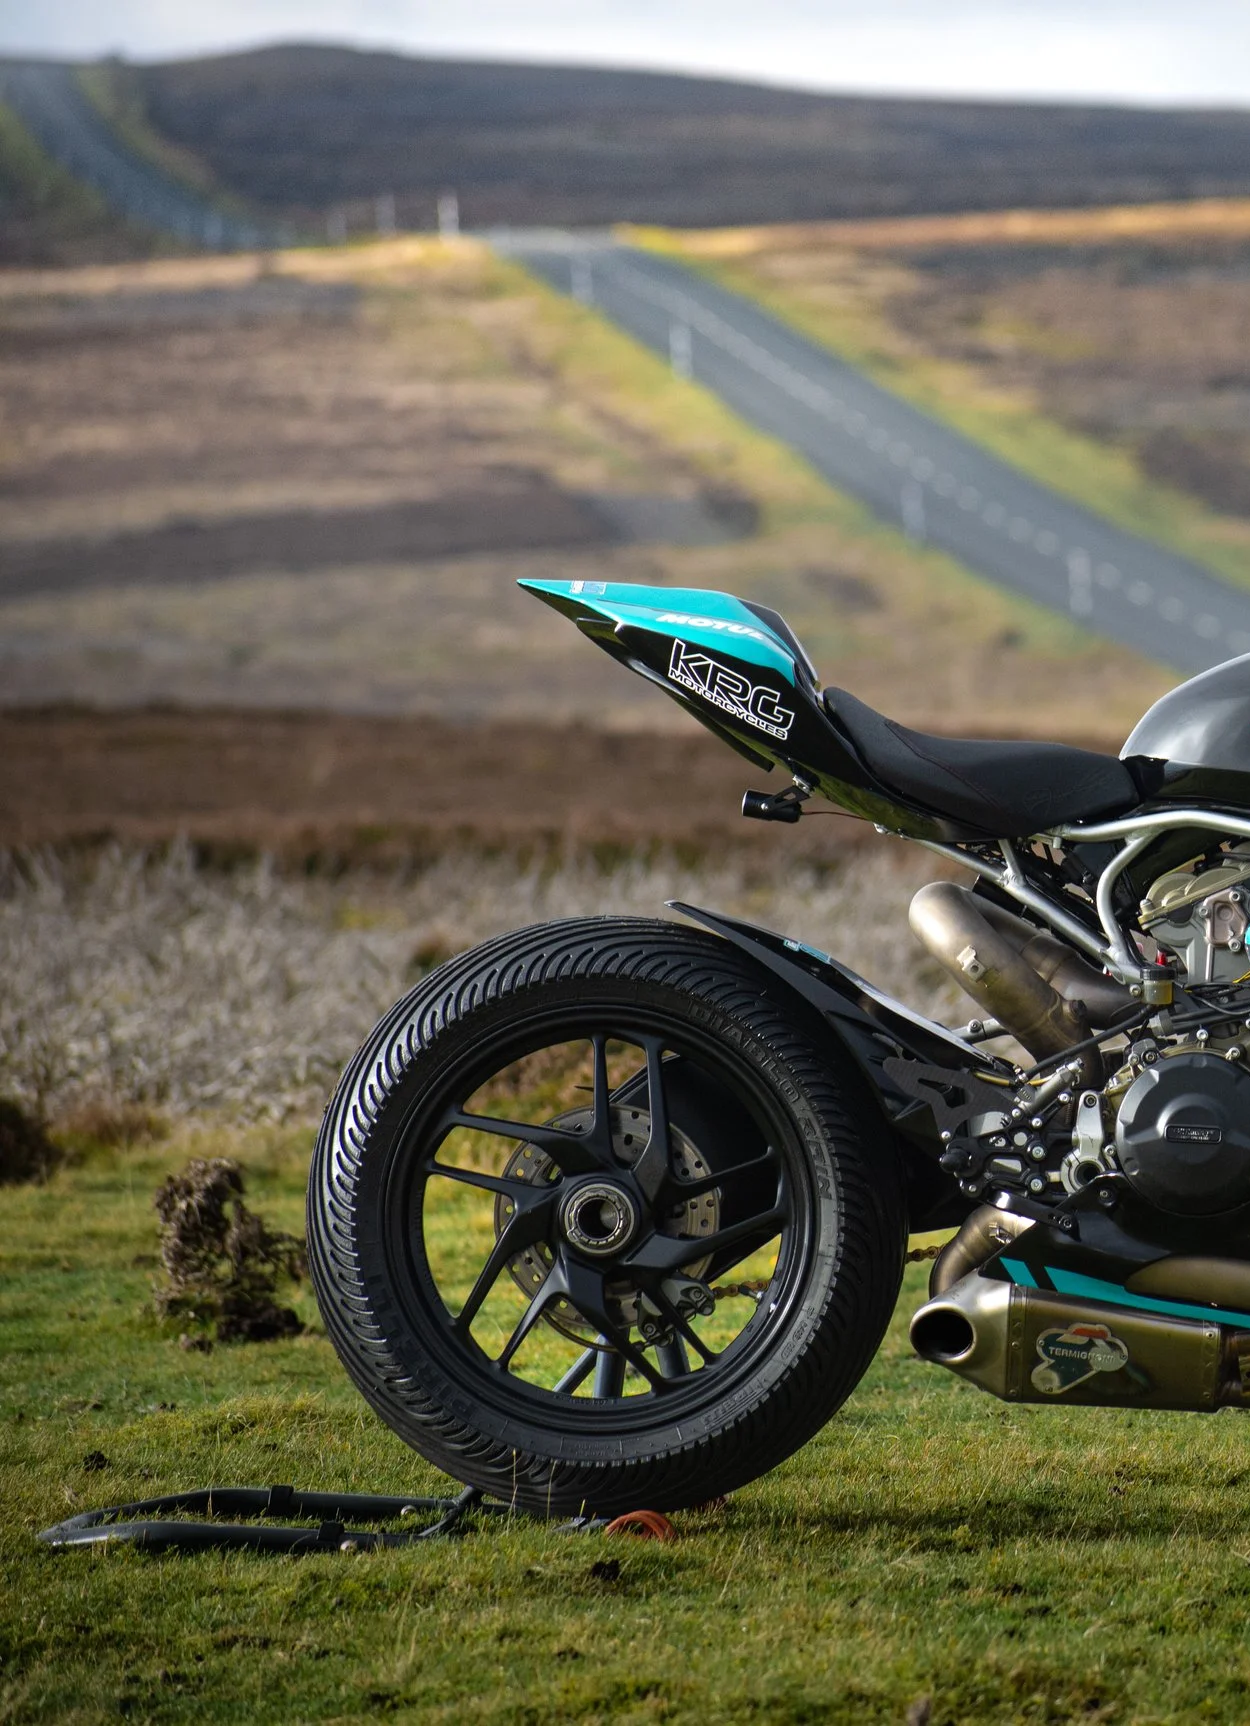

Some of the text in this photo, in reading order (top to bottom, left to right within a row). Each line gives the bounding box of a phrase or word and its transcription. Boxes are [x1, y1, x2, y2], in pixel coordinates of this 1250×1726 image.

[655, 613, 764, 640] MOTUL
[668, 637, 795, 730] KRG
[668, 668, 788, 741] MOTORCYCLES
